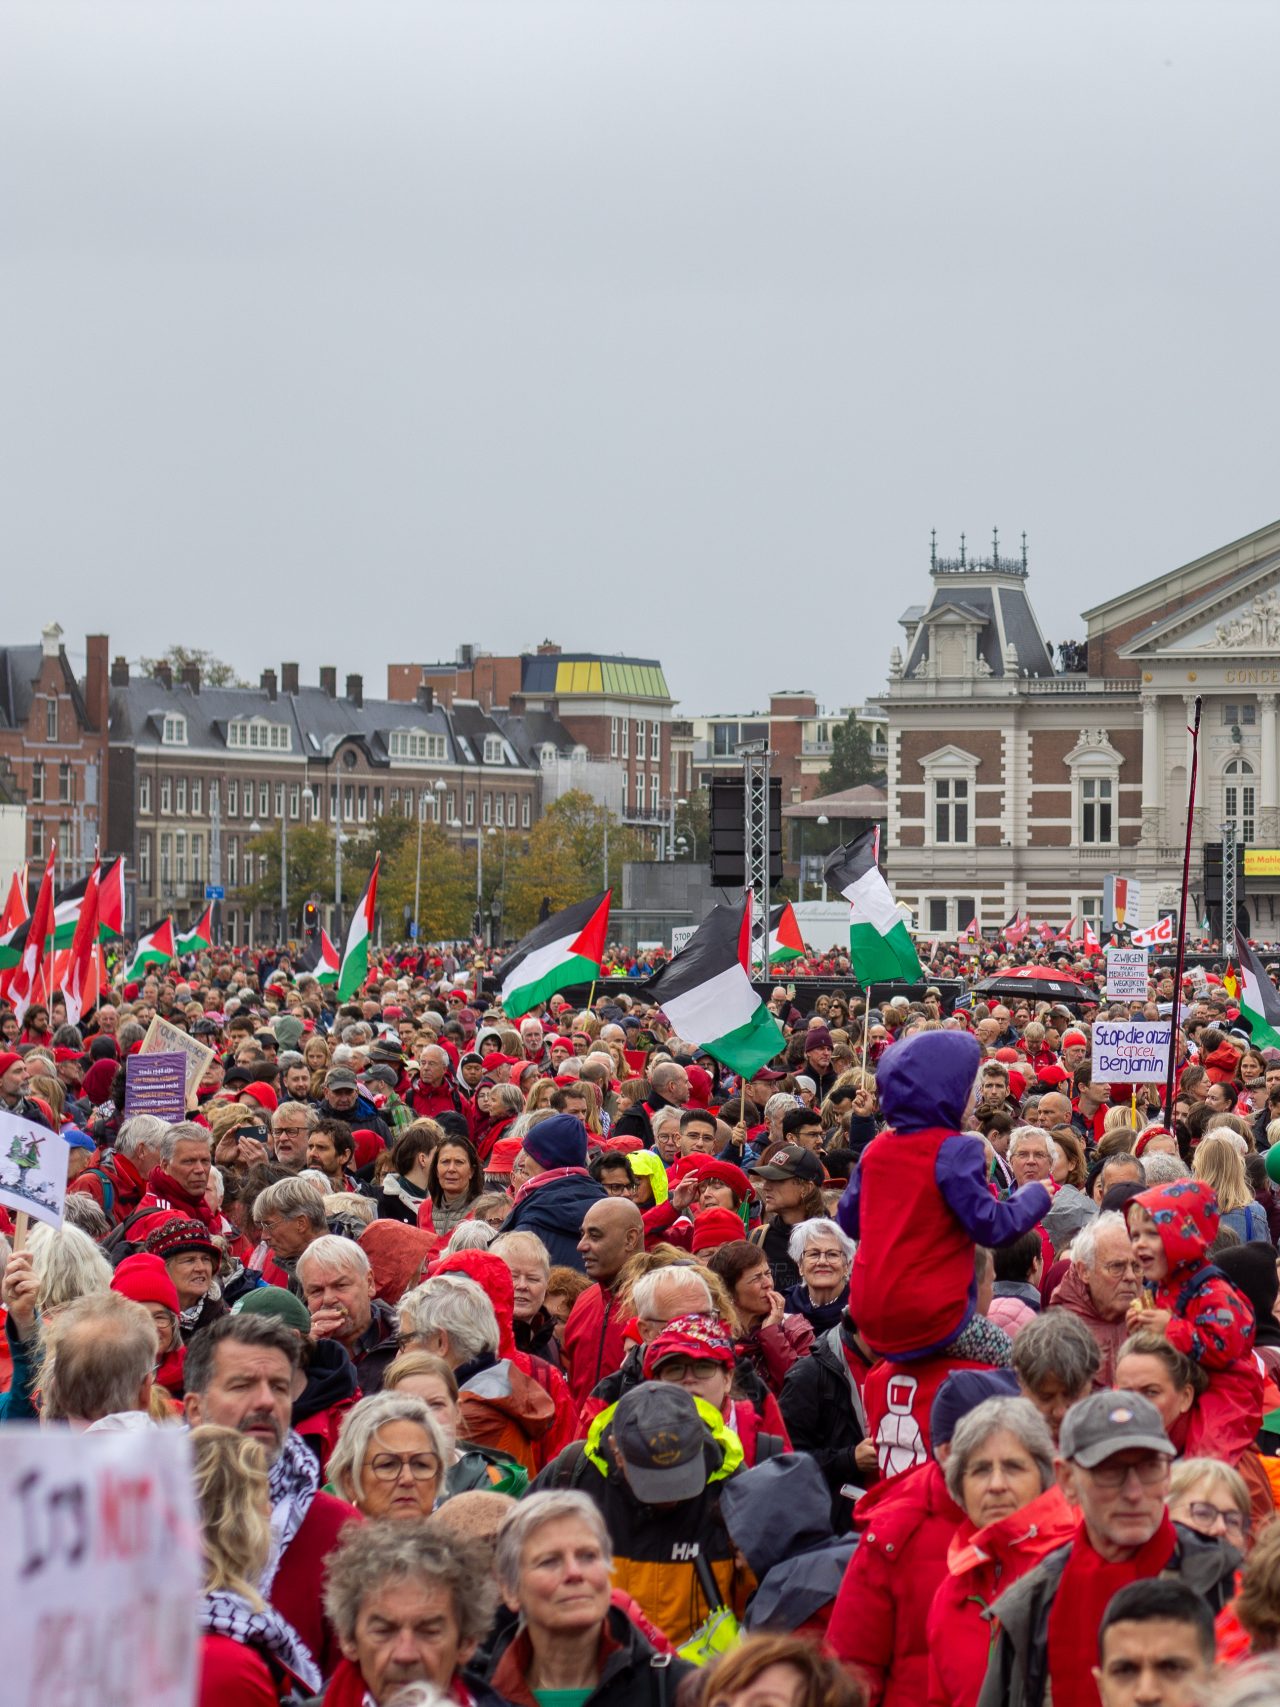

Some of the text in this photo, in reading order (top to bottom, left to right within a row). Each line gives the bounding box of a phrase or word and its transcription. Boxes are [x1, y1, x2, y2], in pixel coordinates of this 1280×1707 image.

[1095, 1026, 1125, 1047] Stop
[1125, 1026, 1144, 1044] die
[1100, 1056, 1163, 1075] Benjamin
